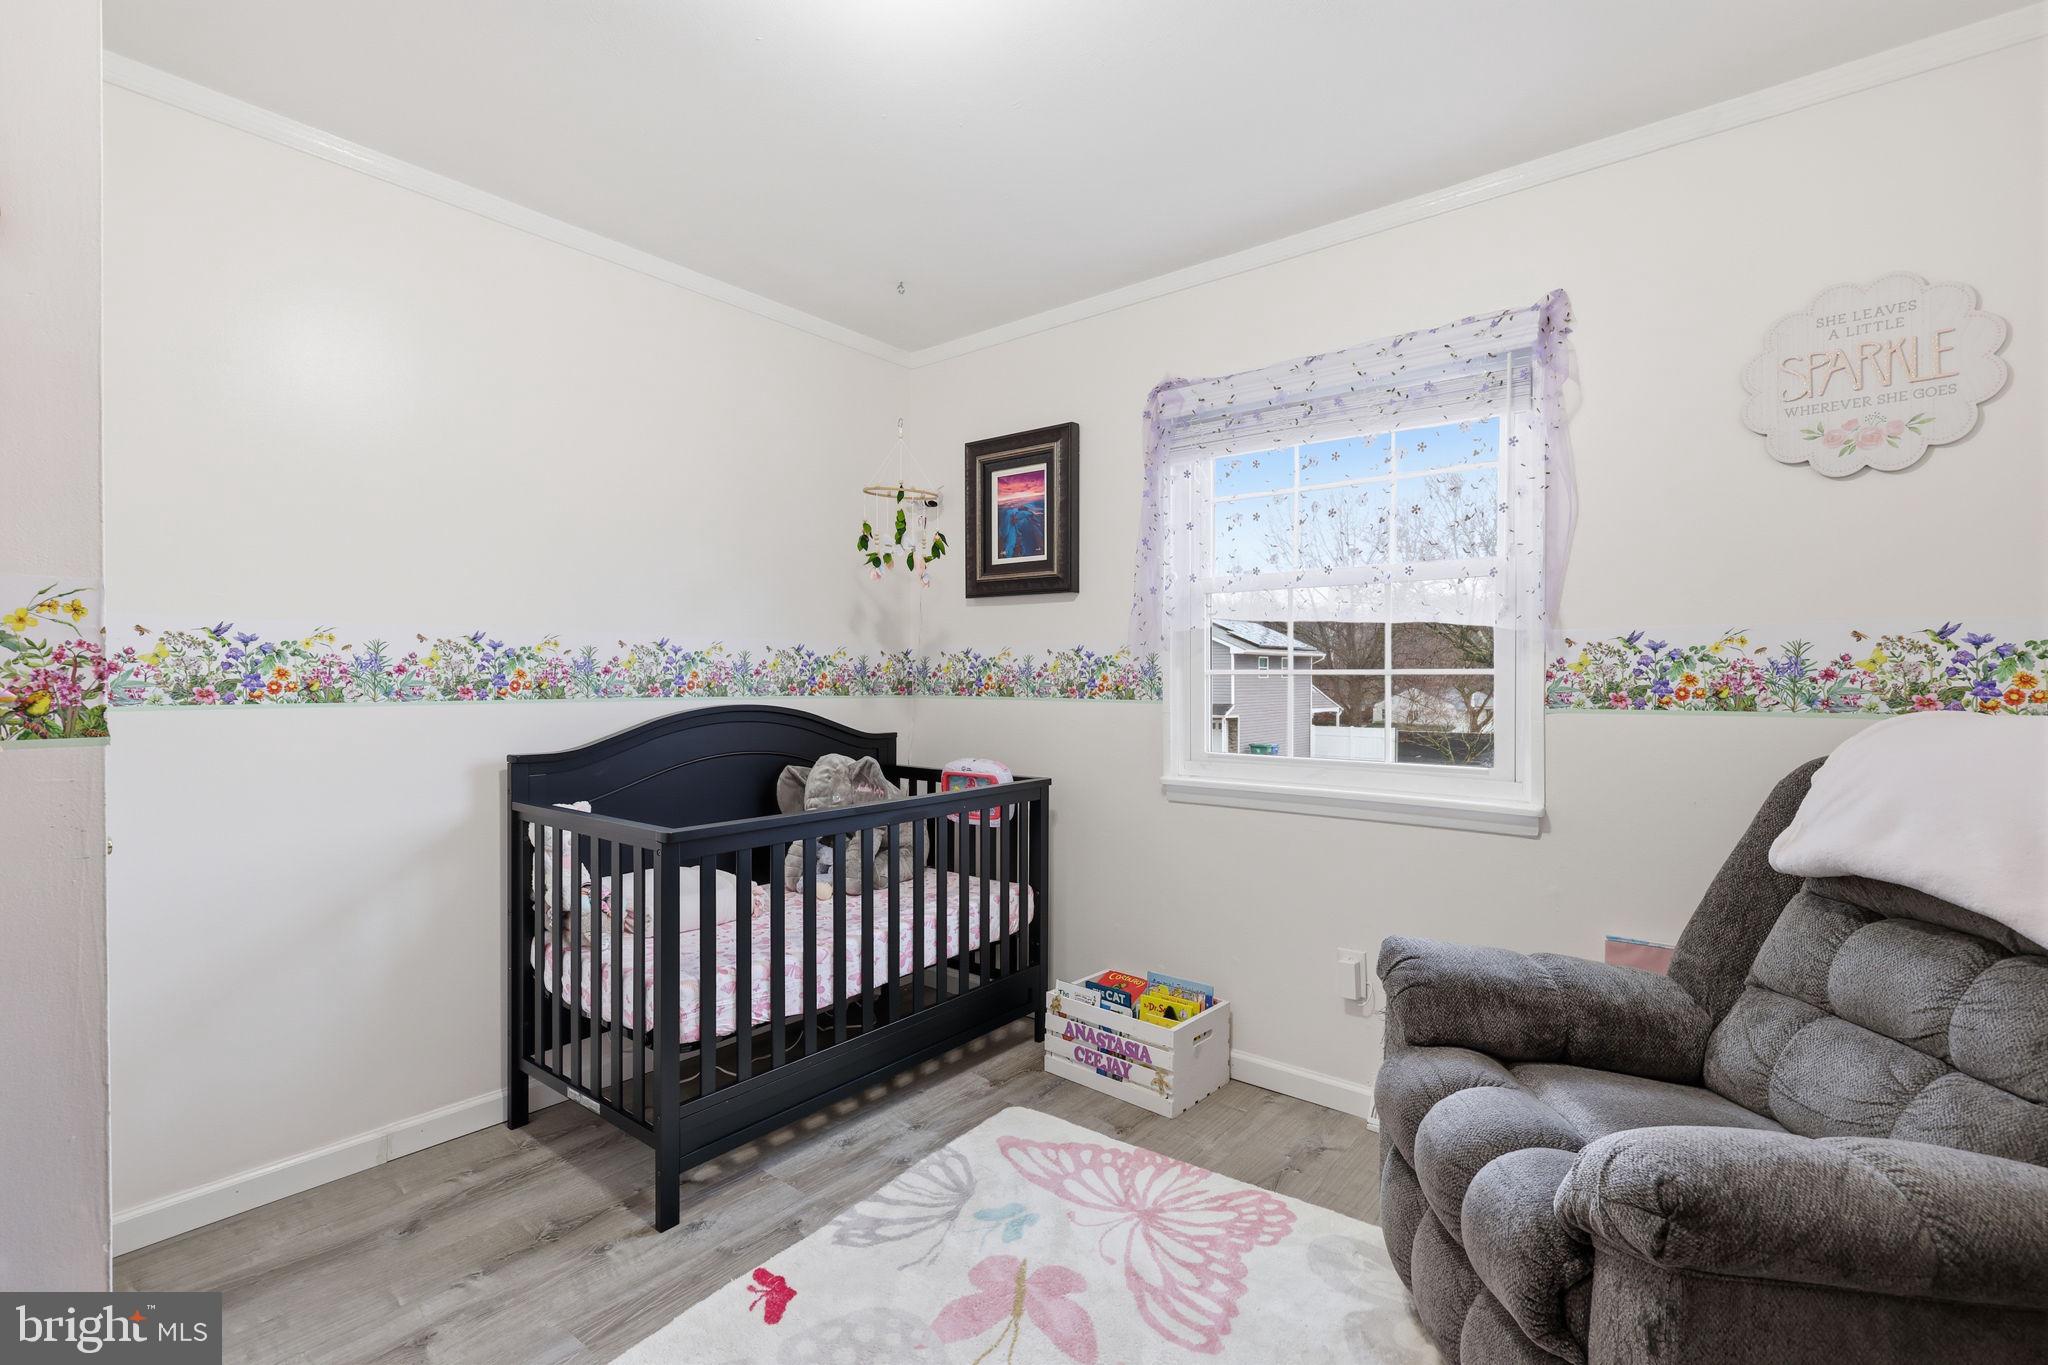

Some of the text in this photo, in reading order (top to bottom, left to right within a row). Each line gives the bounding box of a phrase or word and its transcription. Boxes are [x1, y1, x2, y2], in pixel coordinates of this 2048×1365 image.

[1816, 300, 1918, 329] SHE LEAVES
[1828, 317, 1905, 341] A LITTLE
[1777, 328, 1960, 403] SPARKLE
[1784, 384, 1957, 418] WHEREVER SHE GOES
[1105, 990, 1126, 1005] CAT
[1063, 1020, 1152, 1065] ANASTASIA
[1073, 1045, 1133, 1080] CEEJAY
